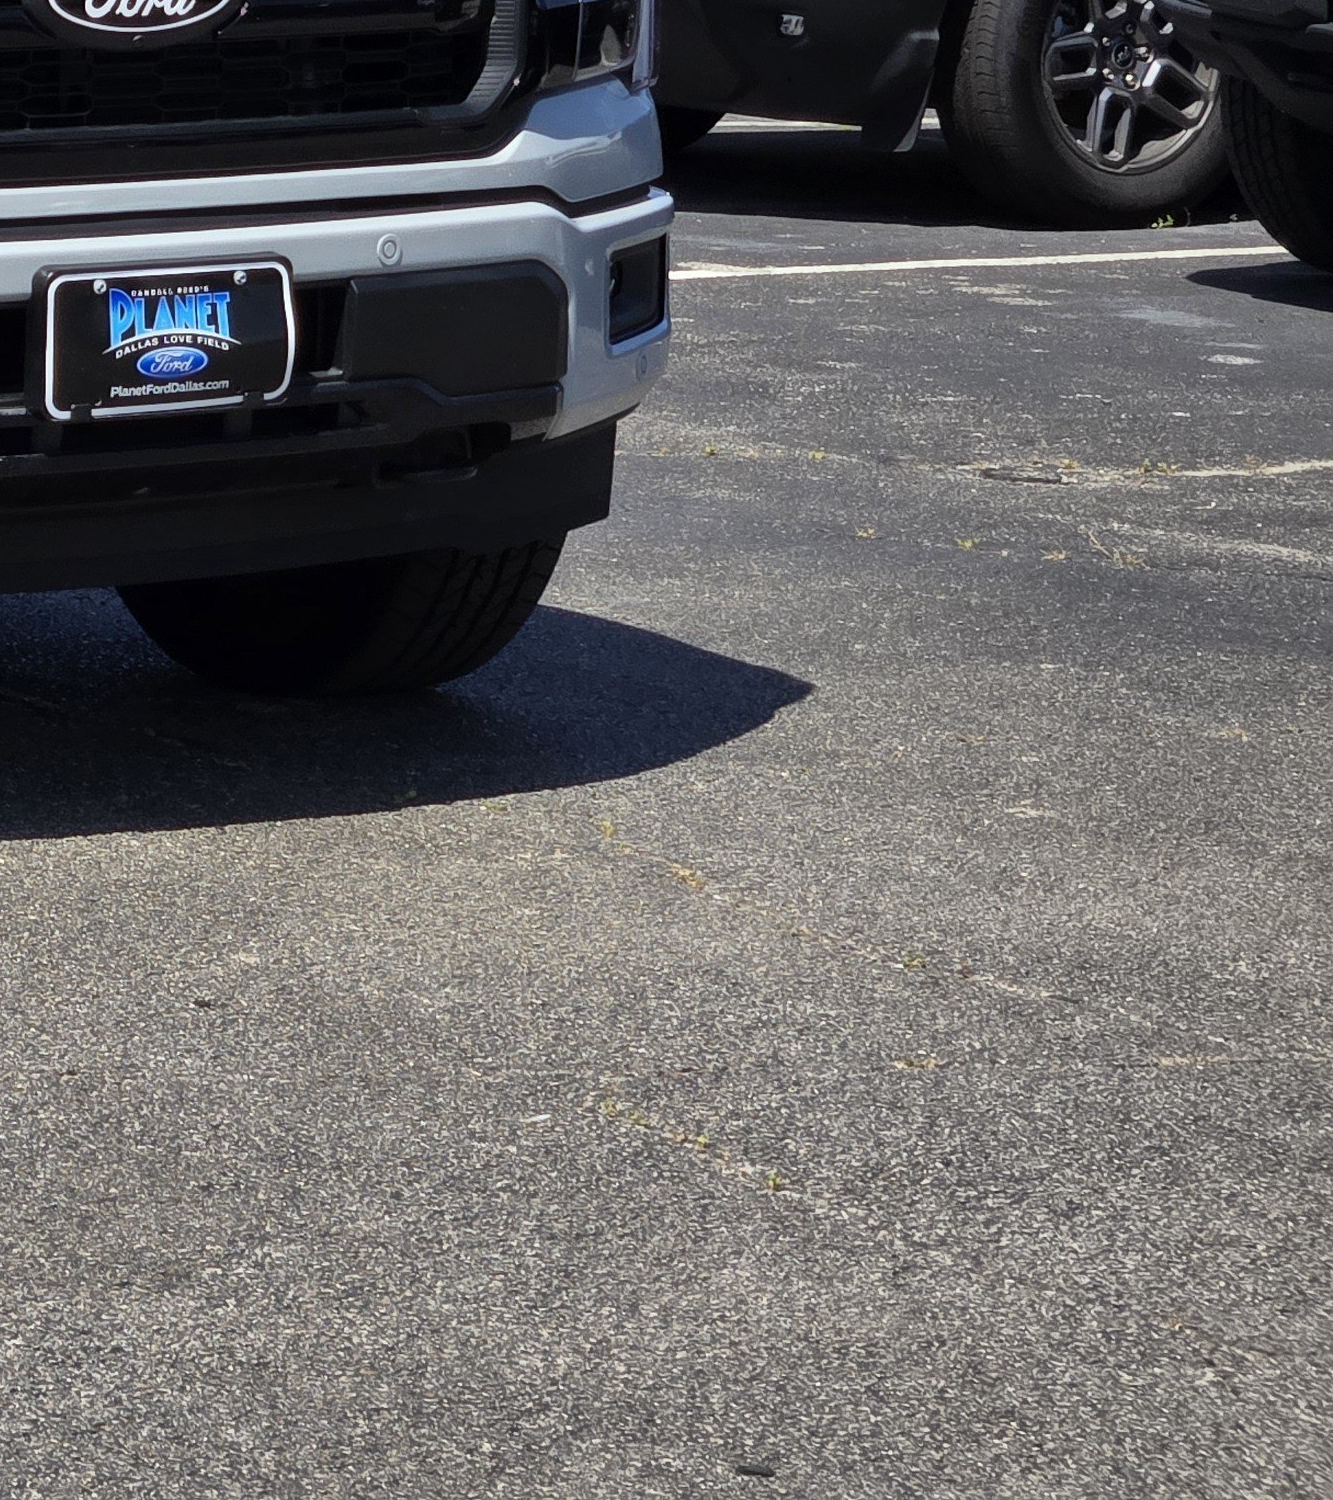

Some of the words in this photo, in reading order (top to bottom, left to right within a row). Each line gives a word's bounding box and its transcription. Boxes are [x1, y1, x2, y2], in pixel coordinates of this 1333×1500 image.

[109, 288, 230, 350] PLANET
[116, 337, 159, 359] DALLAS
[163, 335, 193, 344] LOVE
[197, 336, 230, 351] FIELD
[150, 351, 195, 373] Ford
[110, 380, 230, 398] PlanetFordDallas.com
